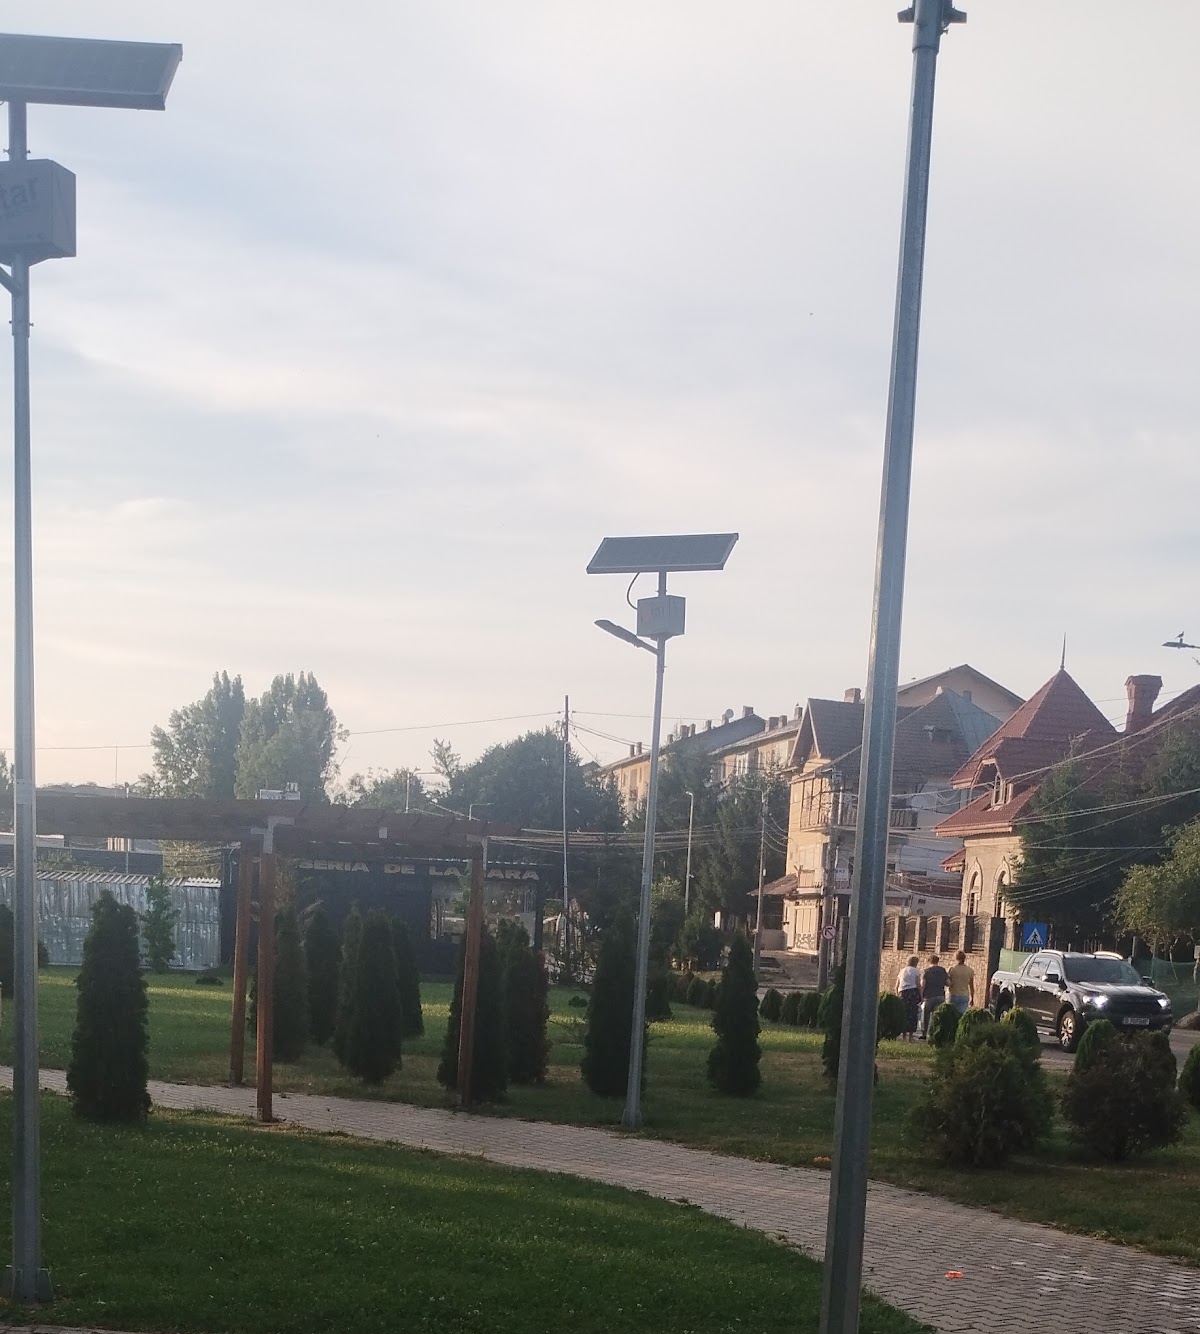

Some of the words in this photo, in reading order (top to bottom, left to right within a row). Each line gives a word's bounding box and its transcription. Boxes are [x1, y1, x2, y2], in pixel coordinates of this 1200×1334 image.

[383, 863, 416, 875] DE
[428, 865, 463, 878] LA
[483, 867, 540, 881] ARA
